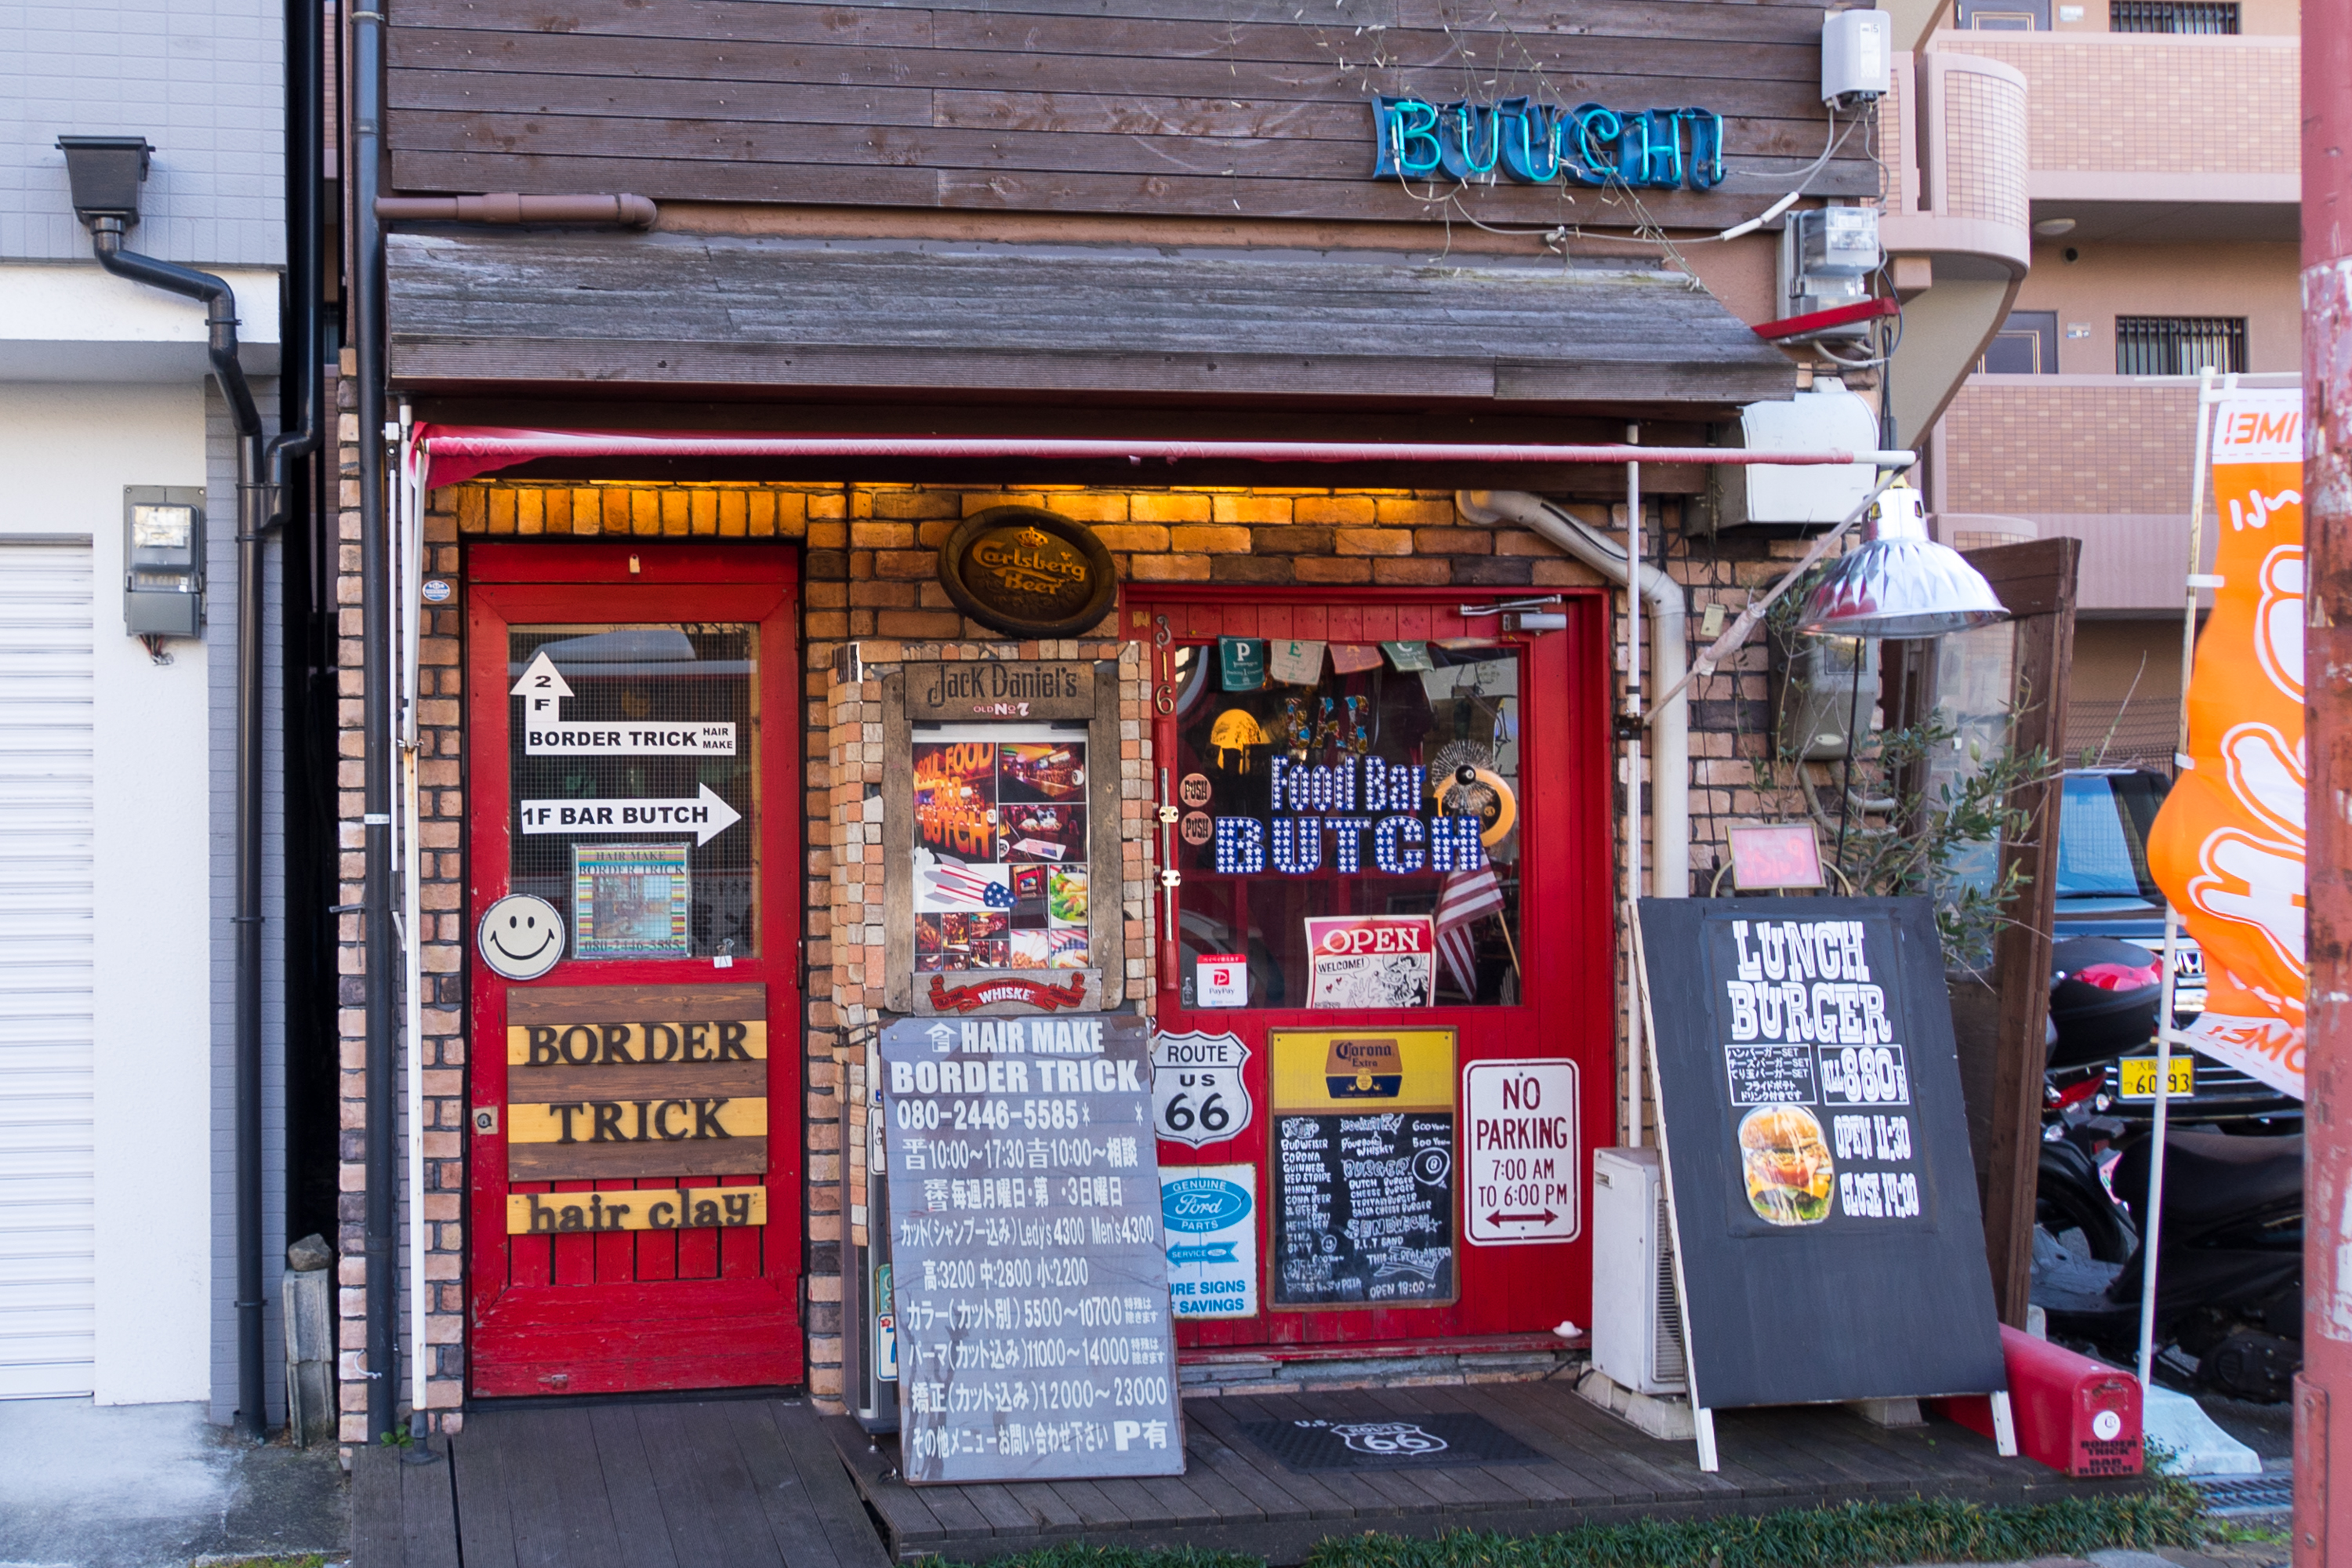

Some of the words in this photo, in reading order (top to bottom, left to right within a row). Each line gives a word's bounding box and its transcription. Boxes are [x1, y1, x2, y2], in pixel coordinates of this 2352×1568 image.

[973, 541, 1087, 583] Carlsberg
[1004, 572, 1062, 595] Beer
[1236, 642, 1251, 661] P
[992, 664, 1077, 698] Daniel's
[535, 676, 551, 711] 2F
[1017, 702, 1029, 717] 7
[529, 731, 621, 746] BORDER
[629, 731, 698, 746] TRICK
[917, 753, 942, 784] SOUL
[945, 742, 994, 775] FOOD
[935, 776, 964, 808] BAR
[1185, 780, 1207, 800] PUSH
[1272, 755, 1356, 811] Food
[1365, 755, 1426, 811] Bar
[523, 808, 551, 826] 1F
[561, 808, 614, 825] BAR
[623, 806, 709, 824] BUTCH
[923, 811, 990, 858] BUTCH
[1185, 817, 1208, 839] PUSH
[1216, 815, 1481, 874] BUTCH
[596, 852, 626, 861] HAIR
[630, 851, 666, 861] MAKE
[579, 865, 636, 875] BORDER
[643, 864, 684, 875] TRICK
[1323, 927, 1420, 953] OPEN
[1732, 920, 1870, 982] LUNCH
[1318, 957, 1364, 974] WELCOME!
[1727, 980, 1892, 1044] BURGER
[524, 1022, 753, 1066] BORDER
[933, 1029, 949, 1051] 2F
[961, 1022, 1025, 1053] HAIR
[1031, 1022, 1105, 1053] MAKE
[1167, 1045, 1228, 1063] ROUTE
[1336, 1041, 1392, 1062] Corona
[1728, 1047, 1799, 1058] ハンバーガーSET
[1352, 1058, 1378, 1067] Extra
[891, 1060, 1029, 1094] BORDER
[1036, 1059, 1142, 1093] TRICK
[1842, 1047, 1896, 1102] 880
[1503, 1077, 1541, 1110] NO
[550, 1098, 732, 1144] TRICK
[897, 1099, 1079, 1131] 080-2446-5585
[1165, 1092, 1229, 1131] 66
[1412, 1120, 1431, 1131] 600
[1476, 1116, 1567, 1151] PARKING
[1281, 1139, 1328, 1151] BUDWEISER
[1833, 1115, 1873, 1160] OPEN
[1873, 1115, 1911, 1161] 11:30
[1282, 1152, 1320, 1163] CORONA
[1356, 1144, 1395, 1157] WHISKEY
[1283, 1163, 1325, 1173] GUINNESS
[1492, 1159, 1526, 1181] 7:00
[1533, 1158, 1555, 1179] AM
[1172, 1179, 1227, 1192] GENUINE
[1284, 1174, 1301, 1184] RED
[1302, 1173, 1331, 1183] STRIPE
[1349, 1179, 1377, 1190] BUTCH
[1384, 1176, 1414, 1187] BURGER
[1284, 1185, 1317, 1194] HINANO
[1311, 1194, 1331, 1203] BEER
[1351, 1189, 1381, 1199] CHEESE
[1385, 1184, 1415, 1196] BURGER
[1479, 1185, 1497, 1207] TO
[1504, 1184, 1540, 1207] 6:00
[1545, 1184, 1567, 1205] PM
[1839, 1172, 1883, 1218] CLOSE
[1881, 1172, 1919, 1218] 14:00
[526, 1193, 630, 1234] hair
[648, 1189, 750, 1229] clay
[1175, 1193, 1223, 1214] Ford
[1402, 1200, 1432, 1213] BURGER
[1181, 1220, 1219, 1231] PARTS
[1381, 1236, 1403, 1247] SAND
[1172, 1249, 1208, 1258] SERVICE
[1200, 1279, 1246, 1294] SIGNS
[1370, 1283, 1395, 1298] OPEN
[1179, 1298, 1244, 1313] SAVINGS
[1363, 1434, 1431, 1450] 66
